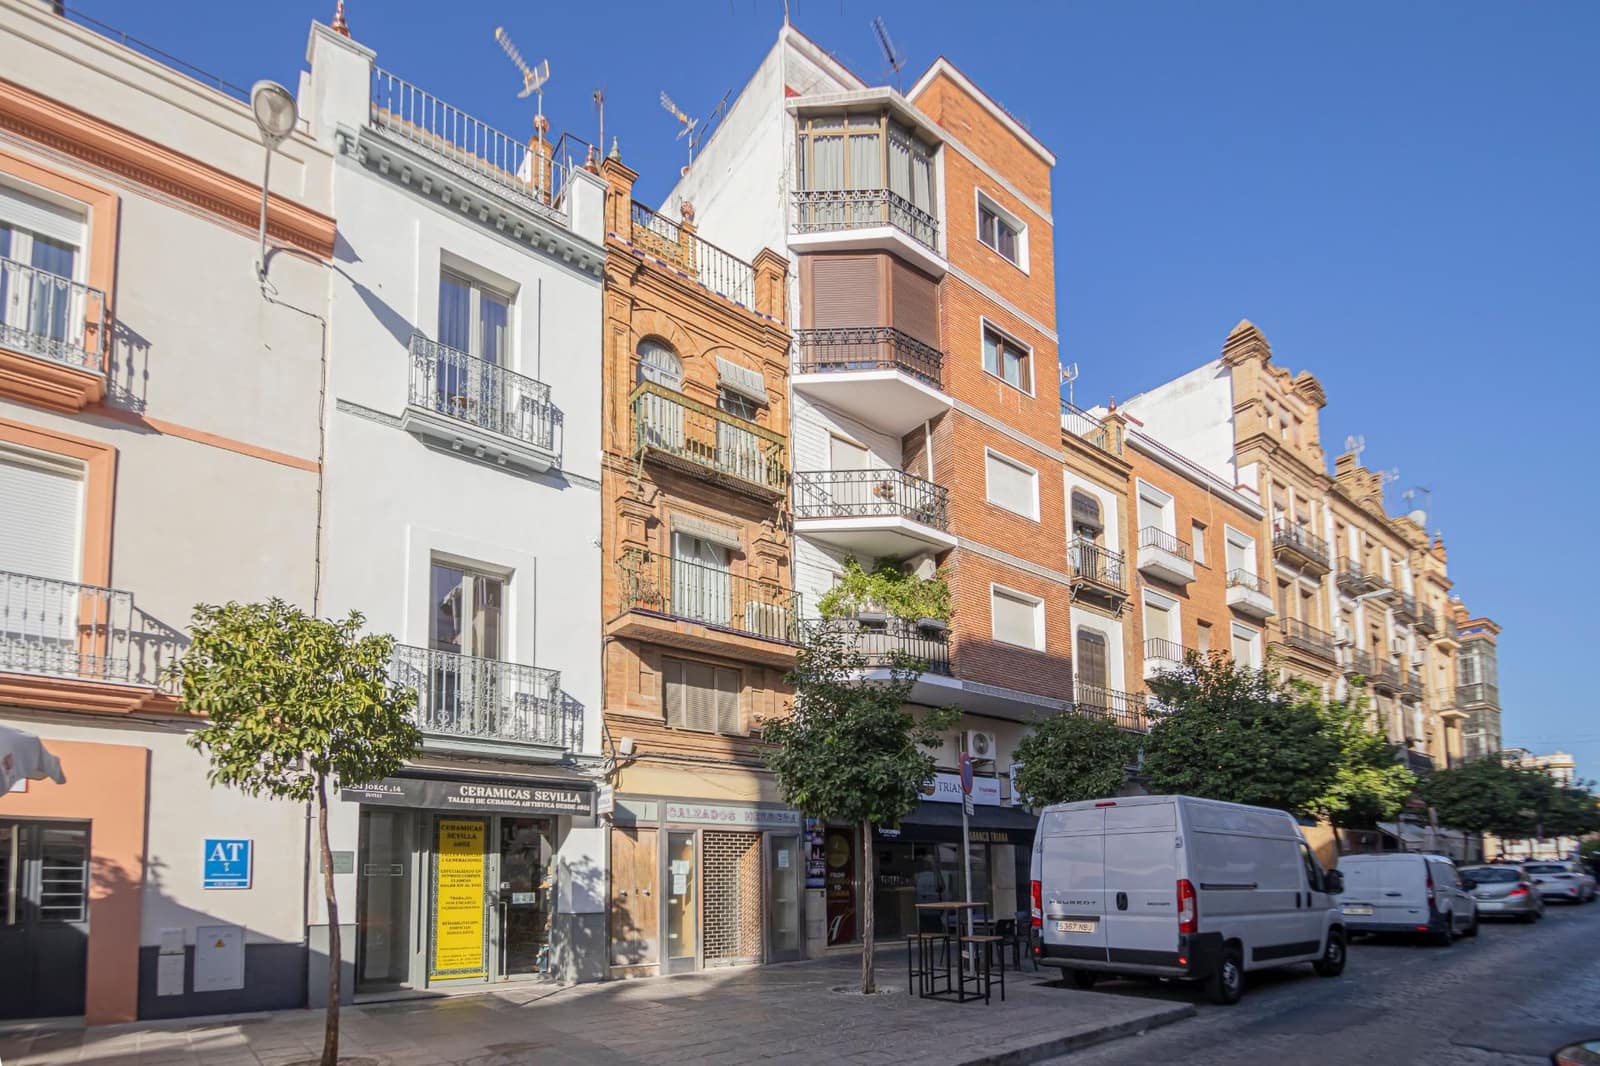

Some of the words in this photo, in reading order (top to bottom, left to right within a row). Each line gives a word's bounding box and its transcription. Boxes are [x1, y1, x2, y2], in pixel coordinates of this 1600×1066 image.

[460, 785, 531, 800] CERAMICAS
[534, 790, 582, 804] SEVILLA
[938, 781, 962, 794] TRIAN
[207, 842, 244, 862] AT
